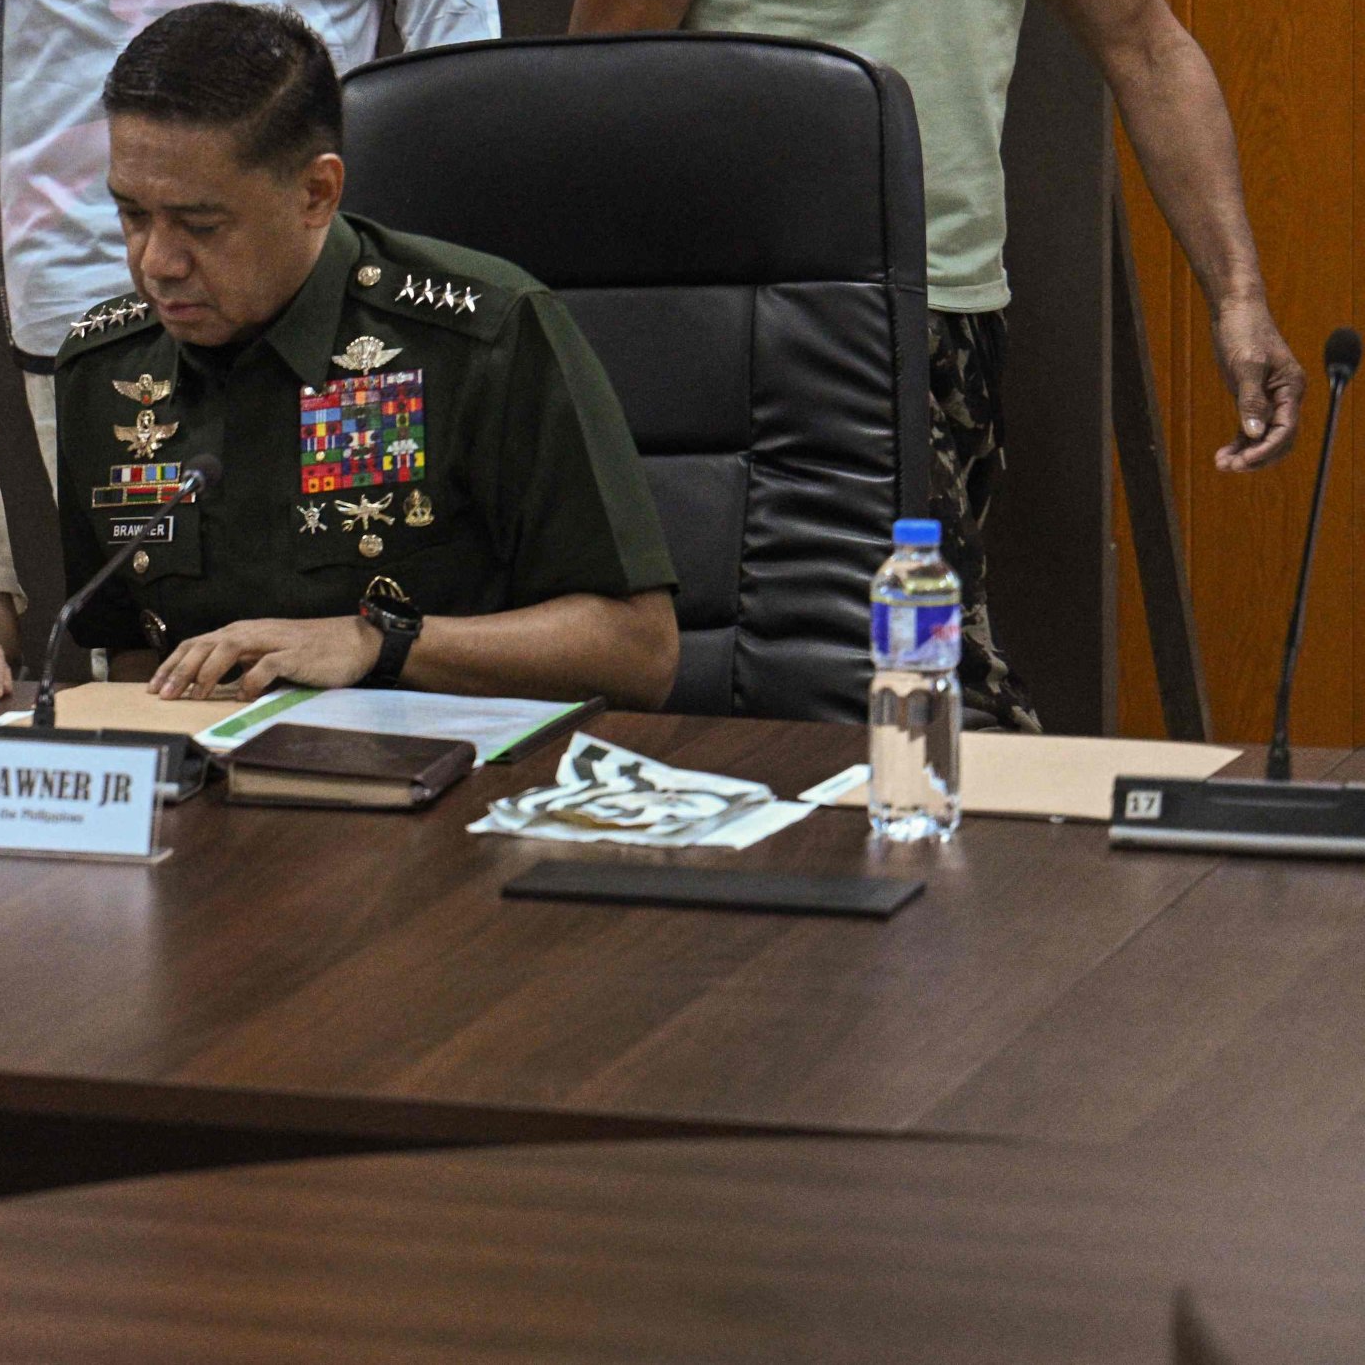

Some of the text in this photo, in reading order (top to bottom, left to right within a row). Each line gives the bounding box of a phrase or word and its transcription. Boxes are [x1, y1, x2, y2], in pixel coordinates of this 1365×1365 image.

[113, 523, 165, 537] BRAWER
[98, 771, 132, 807] JR
[1132, 795, 1155, 813] 17
[0, 808, 16, 820] the
[21, 809, 85, 825] Philippines
